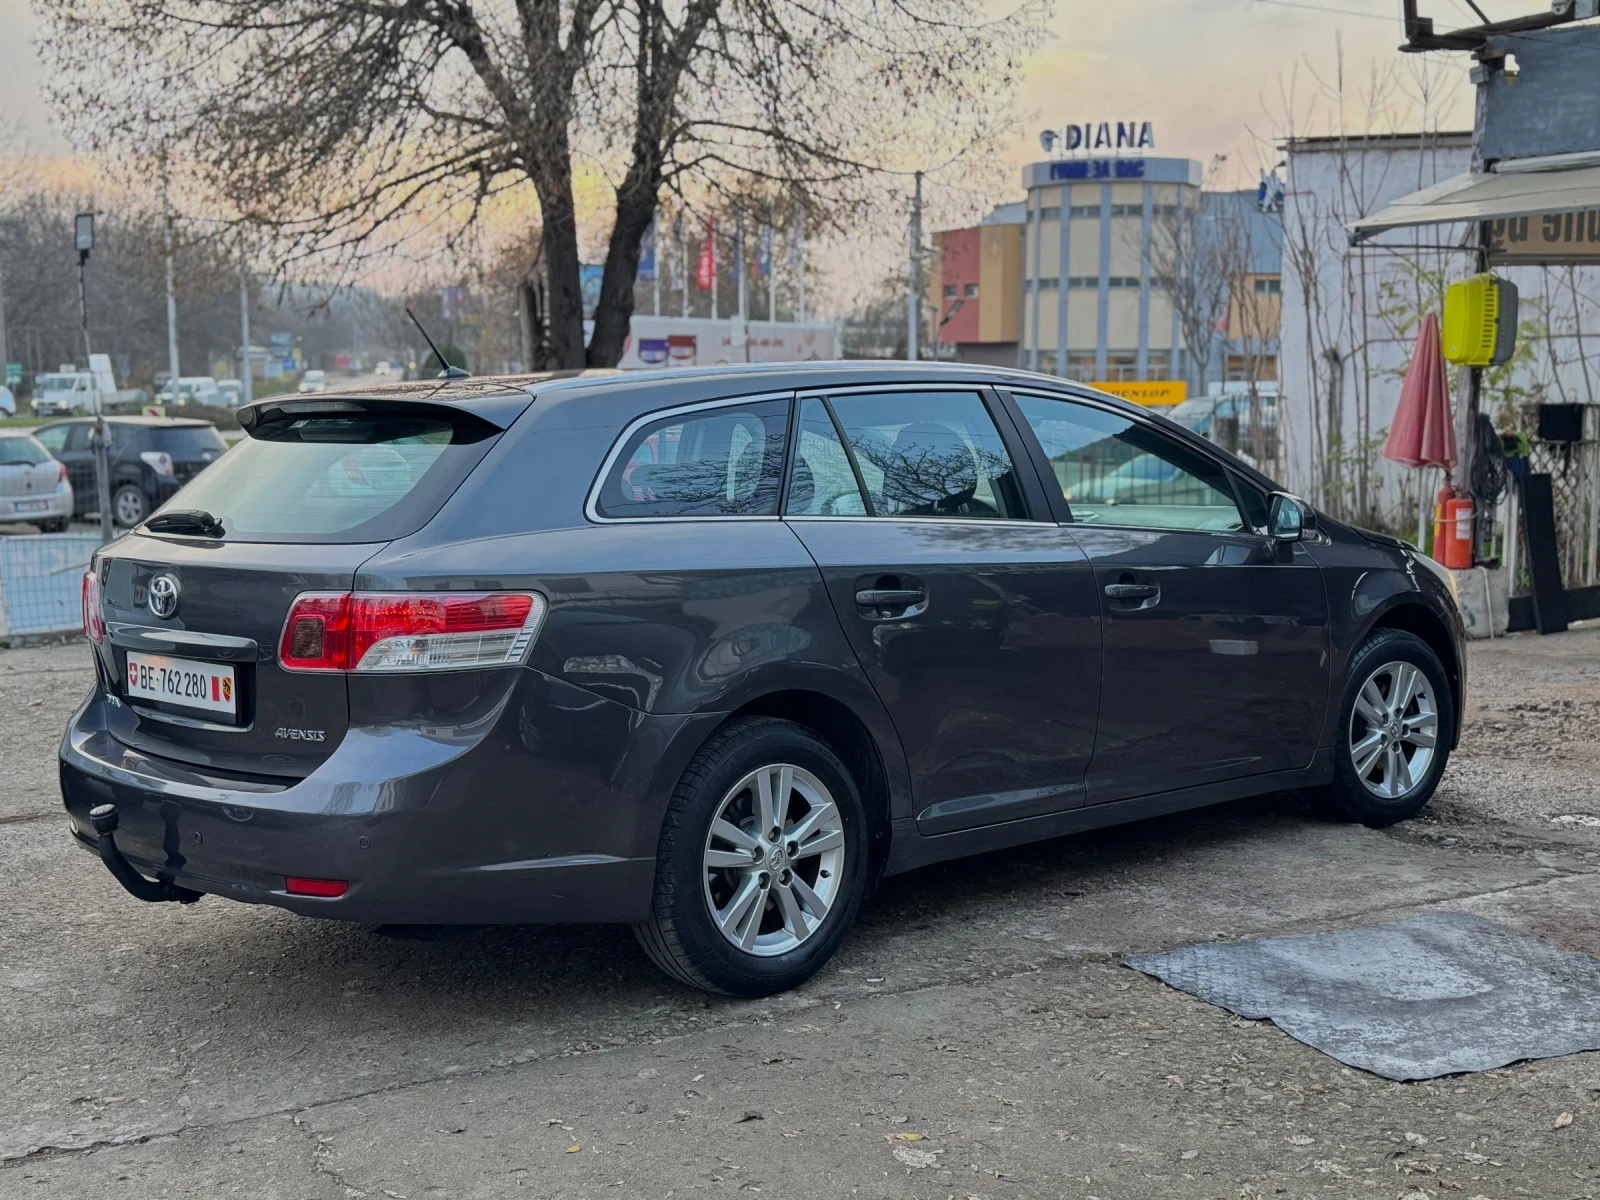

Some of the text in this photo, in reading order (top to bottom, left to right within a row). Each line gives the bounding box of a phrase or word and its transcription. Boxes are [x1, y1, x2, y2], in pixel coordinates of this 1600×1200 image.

[1066, 122, 1155, 150] DIANA
[1111, 388, 1170, 398] DUNLOP
[275, 728, 325, 742] AVENSIS
